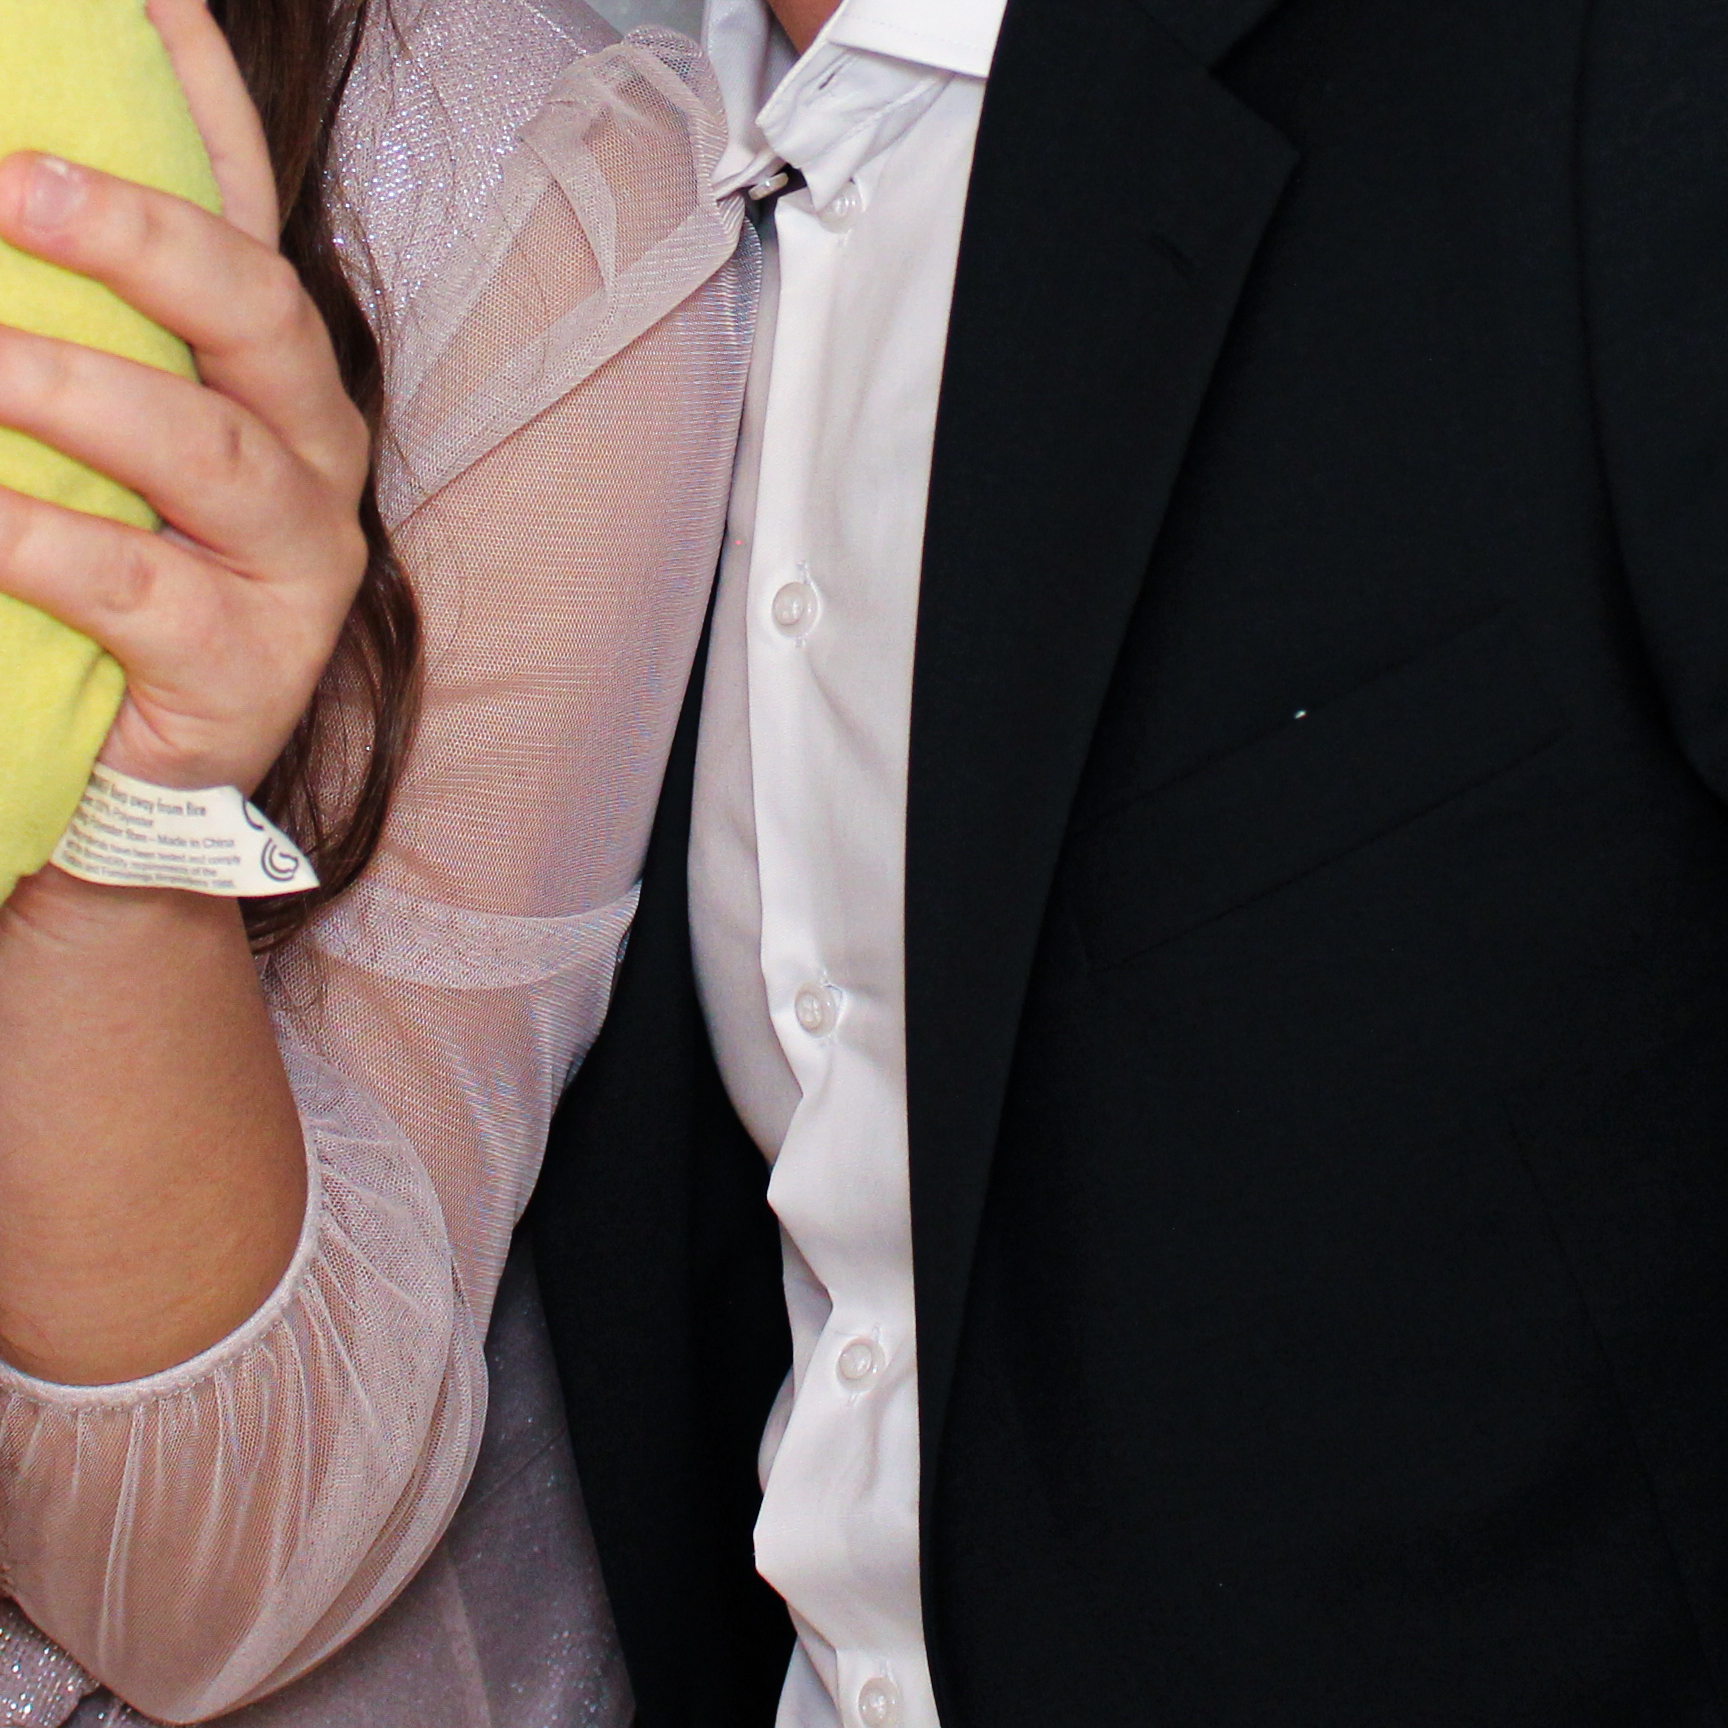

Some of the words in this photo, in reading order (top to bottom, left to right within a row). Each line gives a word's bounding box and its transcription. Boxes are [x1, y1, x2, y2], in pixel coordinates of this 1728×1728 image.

[157, 798, 183, 815] from
[157, 834, 187, 847] Made
[202, 838, 235, 849] China
